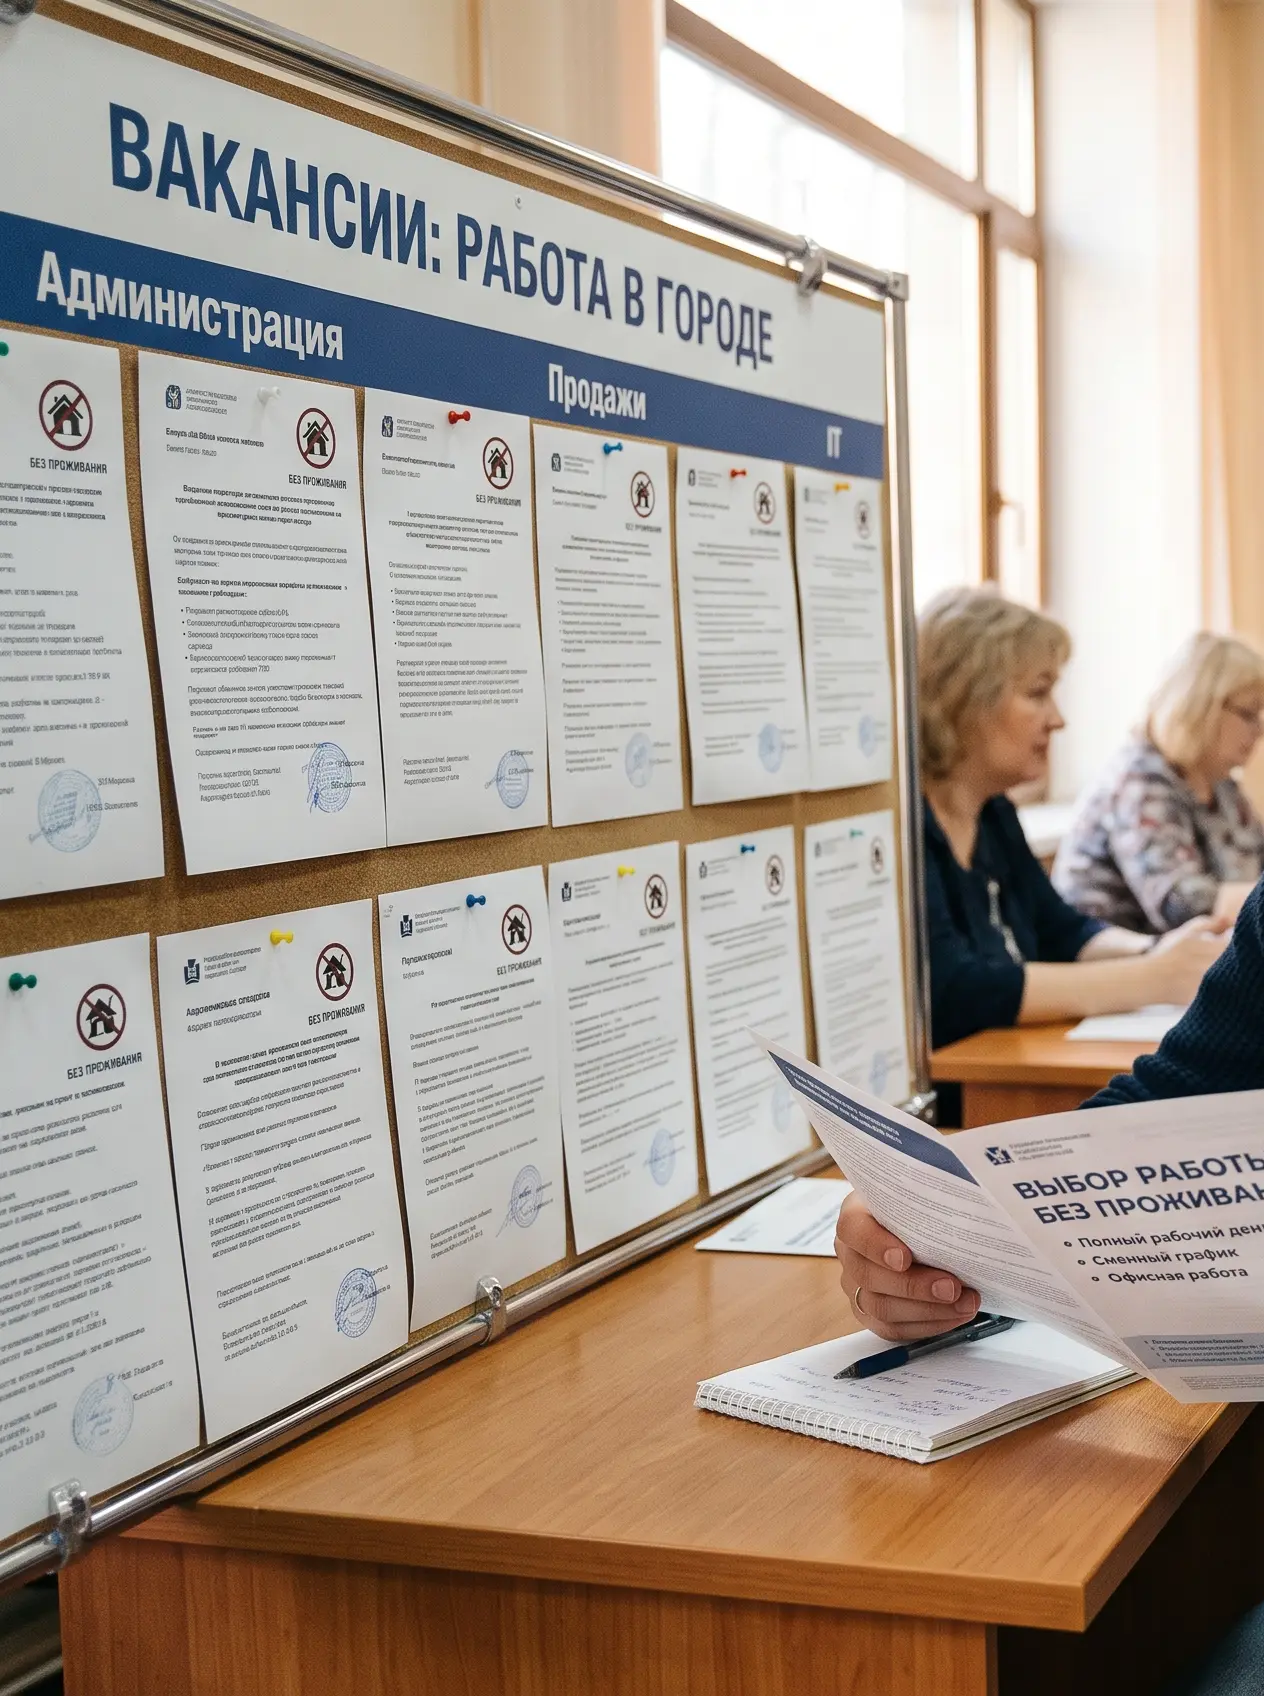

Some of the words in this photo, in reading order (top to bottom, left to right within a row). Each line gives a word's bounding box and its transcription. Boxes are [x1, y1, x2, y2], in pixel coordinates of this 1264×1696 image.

[109, 102, 440, 273] ВАКАНСИИ:
[457, 213, 611, 319] РАБОТА
[625, 267, 644, 326] В
[658, 277, 772, 369] ГОРОДЕ
[37, 251, 343, 360] Администрация
[549, 363, 646, 420] Продажи
[30, 457, 46, 469] БЕЗ
[67, 1066, 84, 1080] БЕЗ
[1013, 1169, 1129, 1200] ВЫБОР
[1033, 1203, 1091, 1225] БЕЗ
[1150, 1226, 1225, 1246] рабочий
[1092, 1251, 1172, 1266] Сменный
[1175, 1248, 1240, 1263] график
[1188, 1267, 1249, 1283] работа
